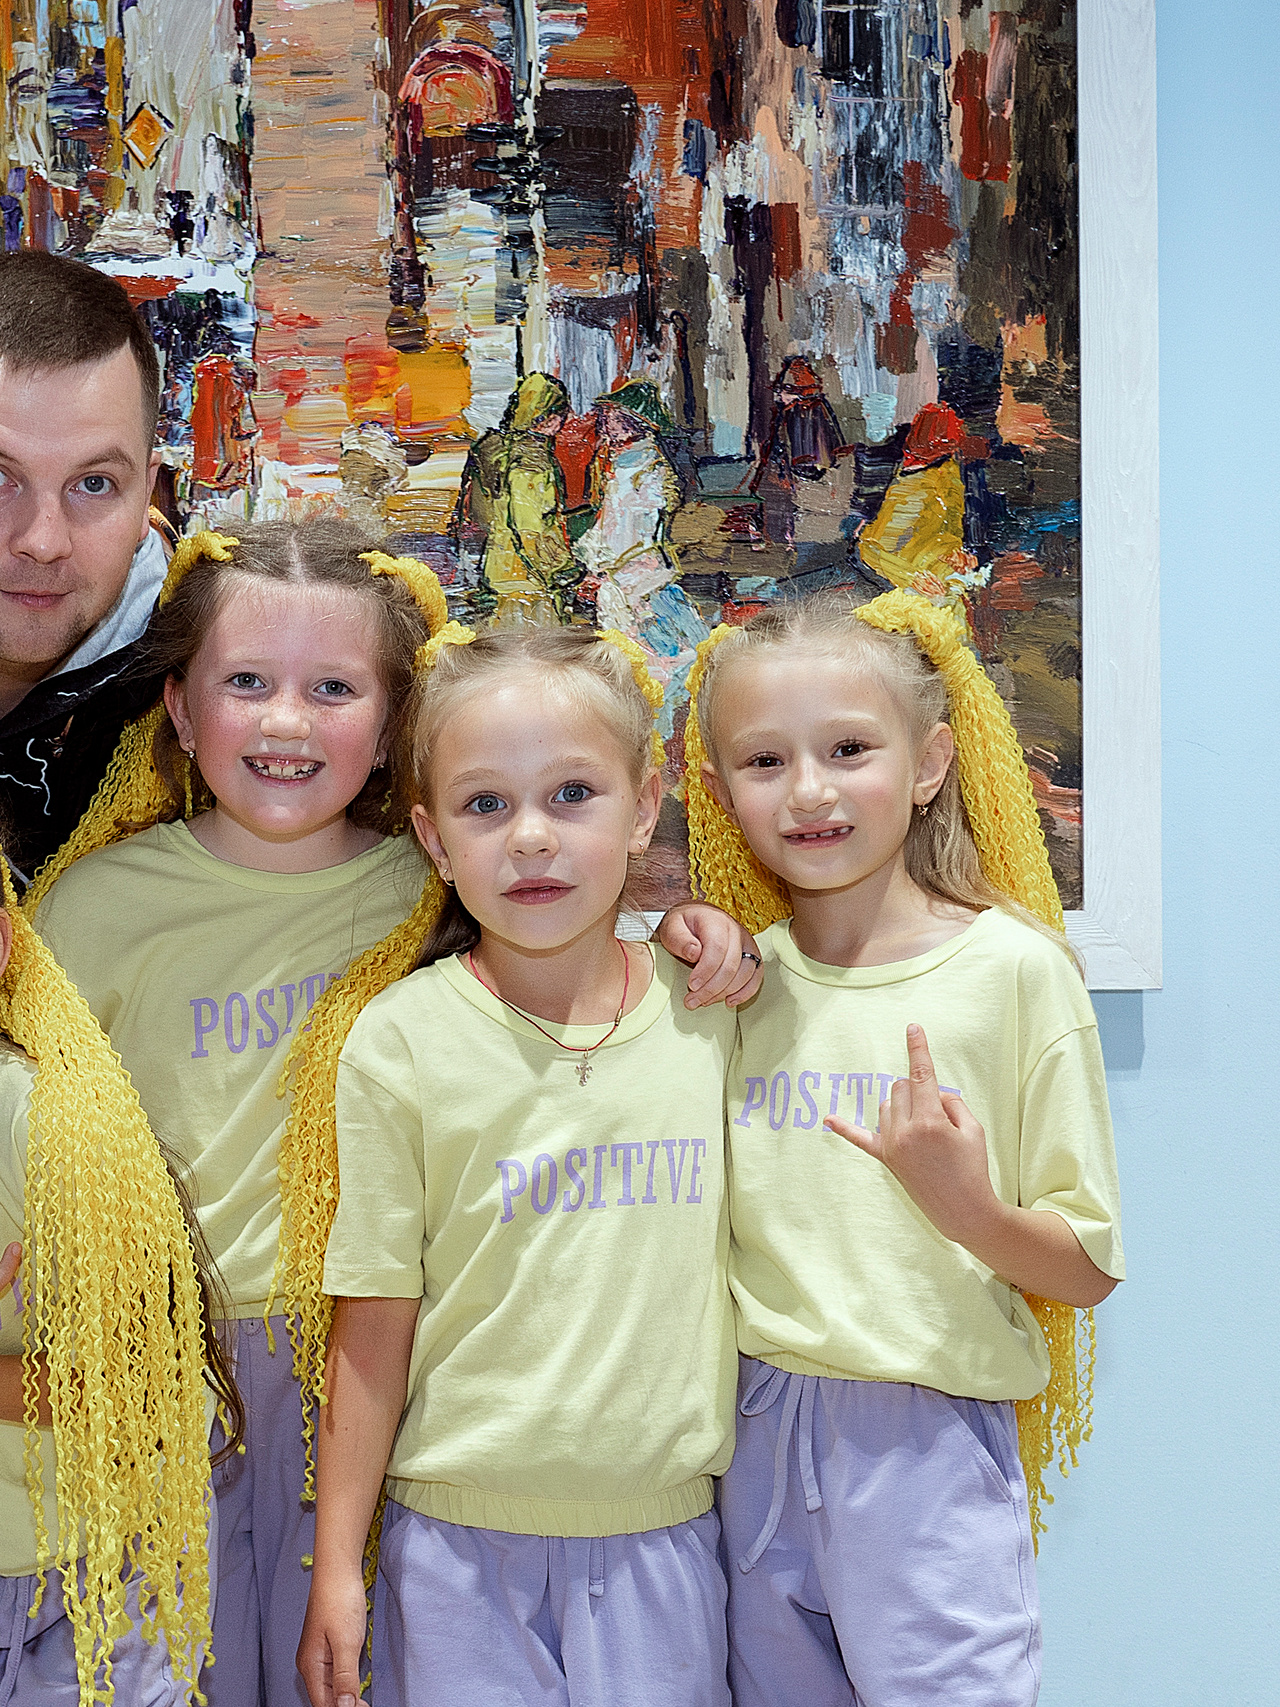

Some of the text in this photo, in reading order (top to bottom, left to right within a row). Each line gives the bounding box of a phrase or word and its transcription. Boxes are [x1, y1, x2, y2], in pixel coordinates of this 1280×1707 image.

[189, 972, 346, 1058] POSIT
[733, 1070, 962, 1132] POSITI
[495, 1138, 706, 1224] POSITIVE
